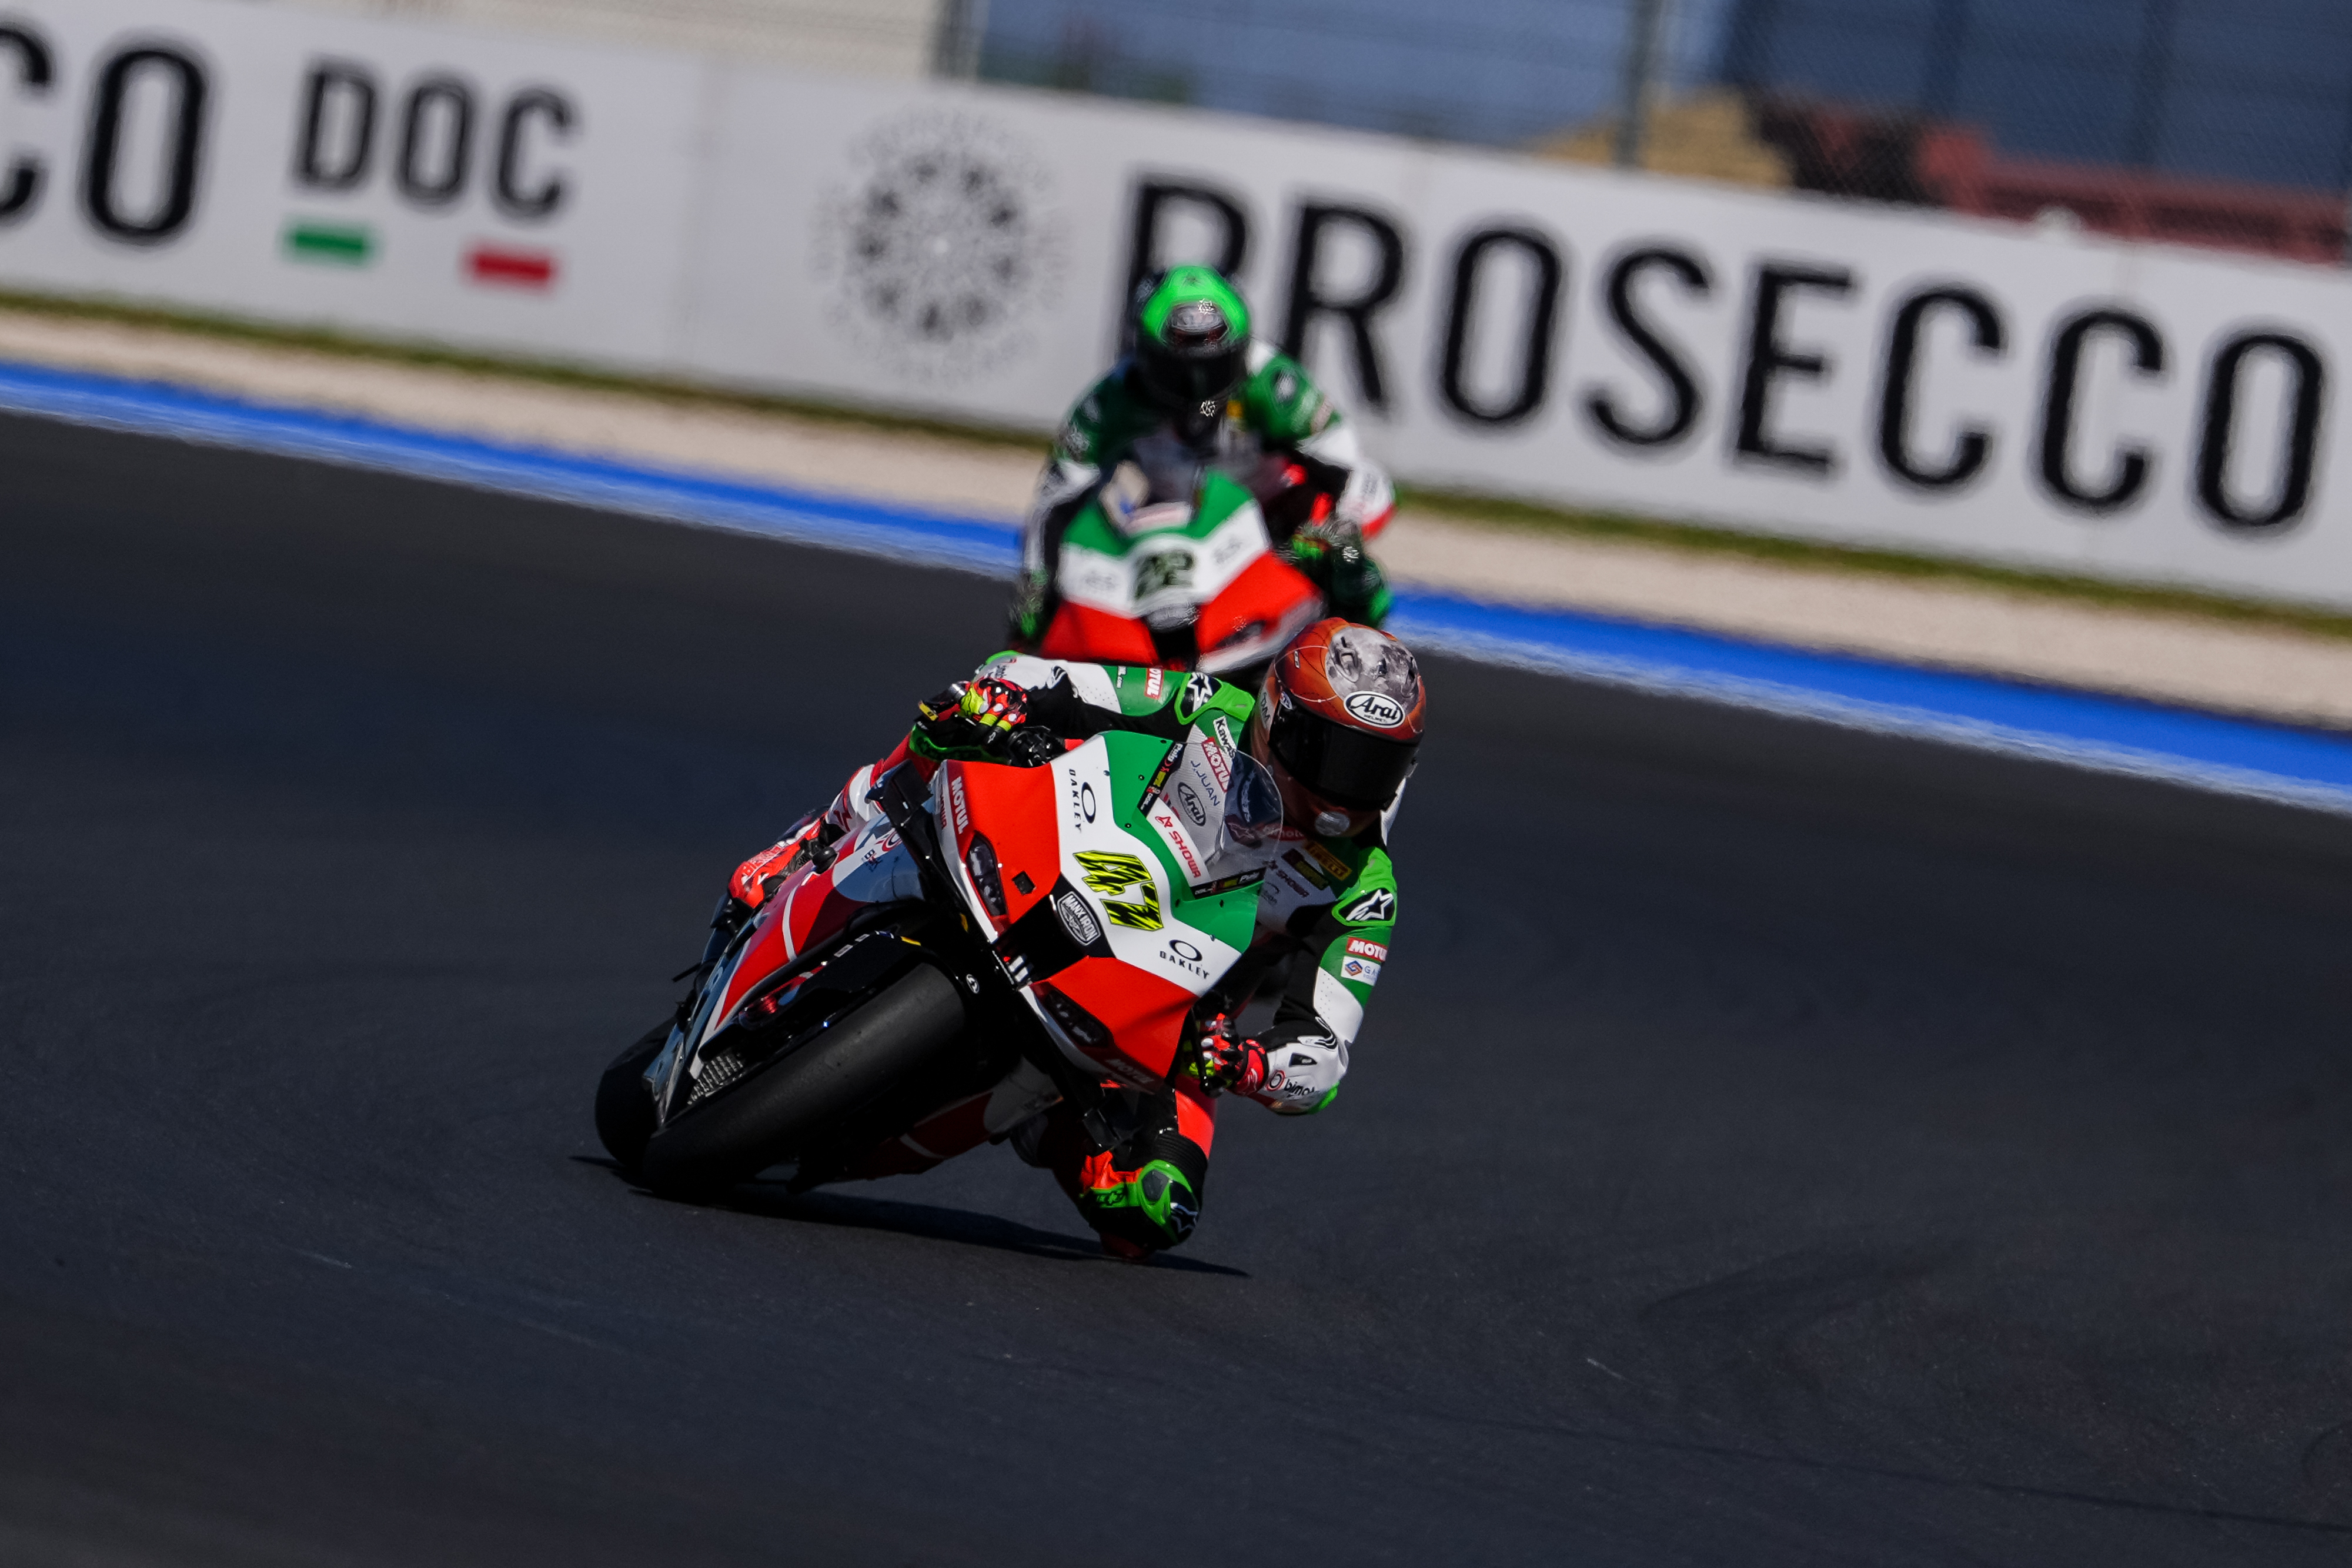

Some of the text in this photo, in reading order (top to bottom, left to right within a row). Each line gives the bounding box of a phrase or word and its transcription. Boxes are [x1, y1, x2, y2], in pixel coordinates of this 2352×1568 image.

[294, 63, 575, 220] DOC
[1114, 172, 2330, 534] PROSECCO
[1147, 668, 1162, 696] OTUL
[1348, 696, 1399, 720] Arai
[951, 775, 969, 835] MOTUL
[1068, 768, 1082, 834] OAKLEY
[1178, 787, 1206, 821] Arai
[1168, 830, 1201, 878] SHOWA
[1073, 850, 1164, 932] 47
[1061, 894, 1098, 941] MANX IRON
[1159, 950, 1210, 979] OAKLEY
[1348, 940, 1388, 962] MOTU
